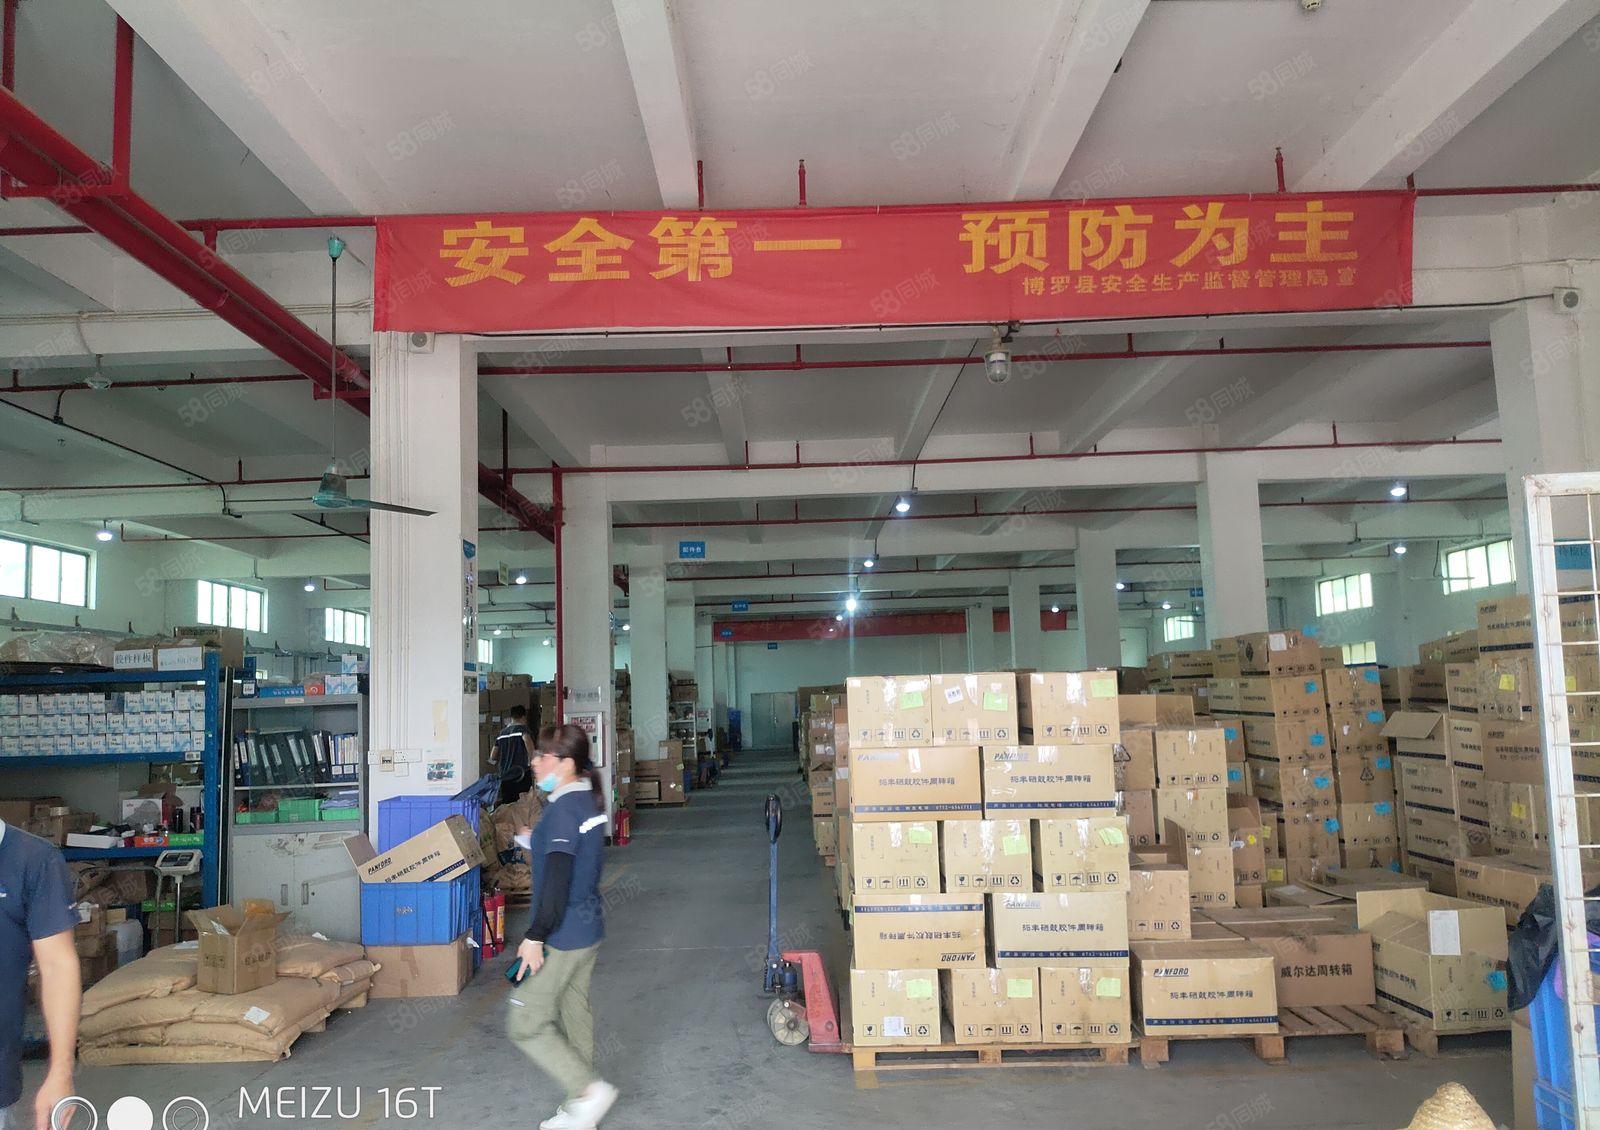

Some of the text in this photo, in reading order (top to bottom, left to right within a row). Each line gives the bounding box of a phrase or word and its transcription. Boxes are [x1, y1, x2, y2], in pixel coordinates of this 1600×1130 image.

[439, 200, 1356, 286] 安全第一 预防为主
[1280, 963, 1353, 979] 威尔达周转箱
